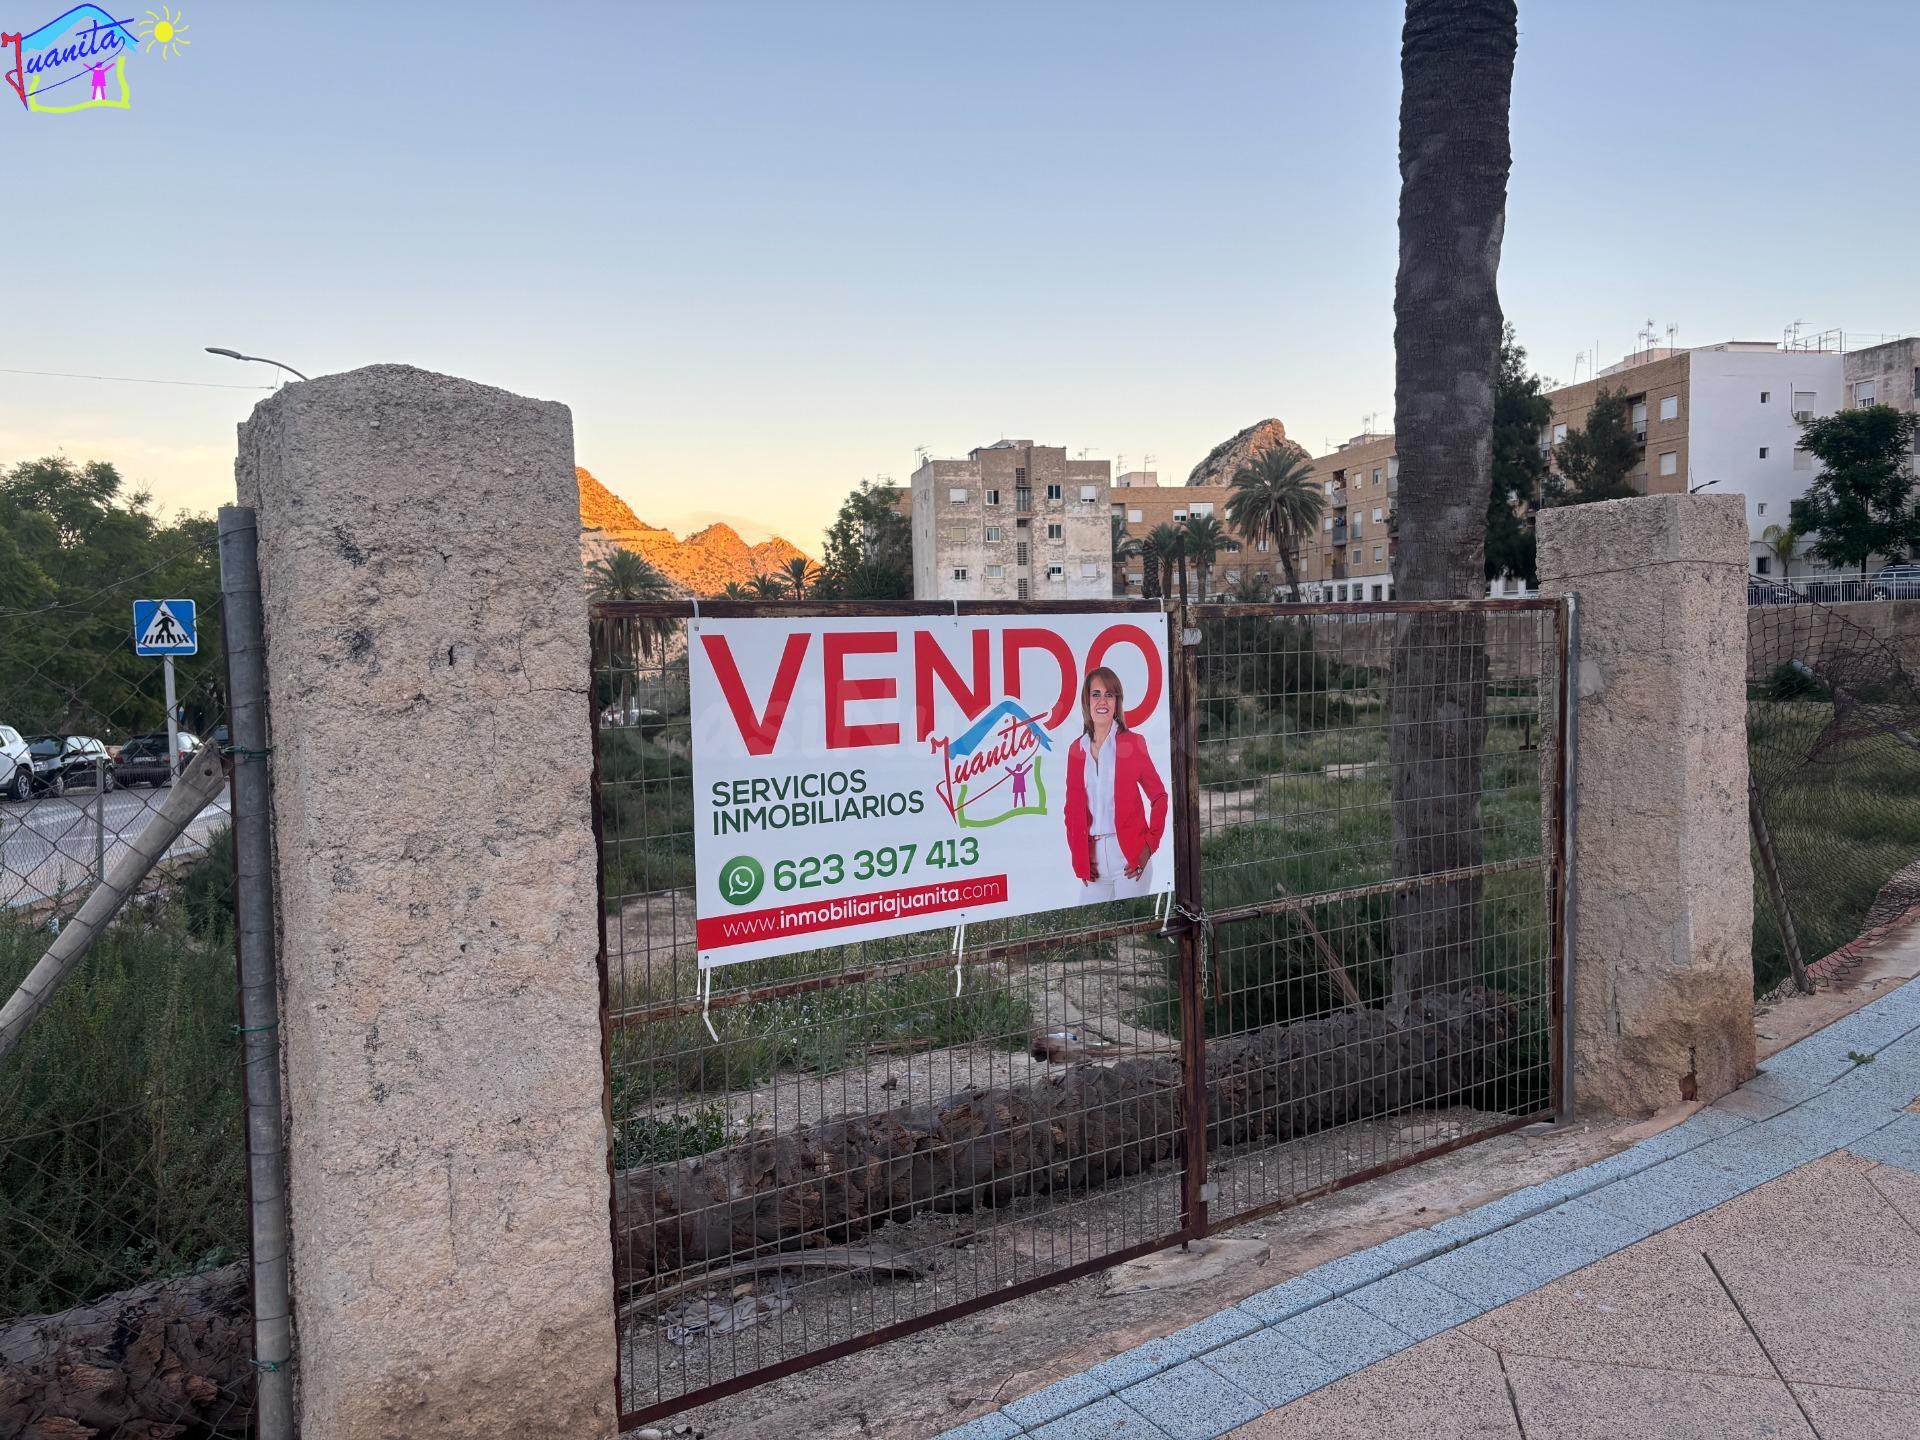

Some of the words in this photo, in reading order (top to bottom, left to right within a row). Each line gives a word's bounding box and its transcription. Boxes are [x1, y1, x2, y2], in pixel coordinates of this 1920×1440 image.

[700, 624, 1163, 756] VENDO
[711, 769, 867, 807] SERVICIOS
[931, 711, 1049, 825] Juanita
[713, 790, 925, 836] INMOBILIARIOS
[773, 853, 845, 892] 623
[853, 843, 918, 881] 397
[925, 836, 980, 869] 413
[722, 879, 1001, 937] www.inmobiliariajuanita.com
